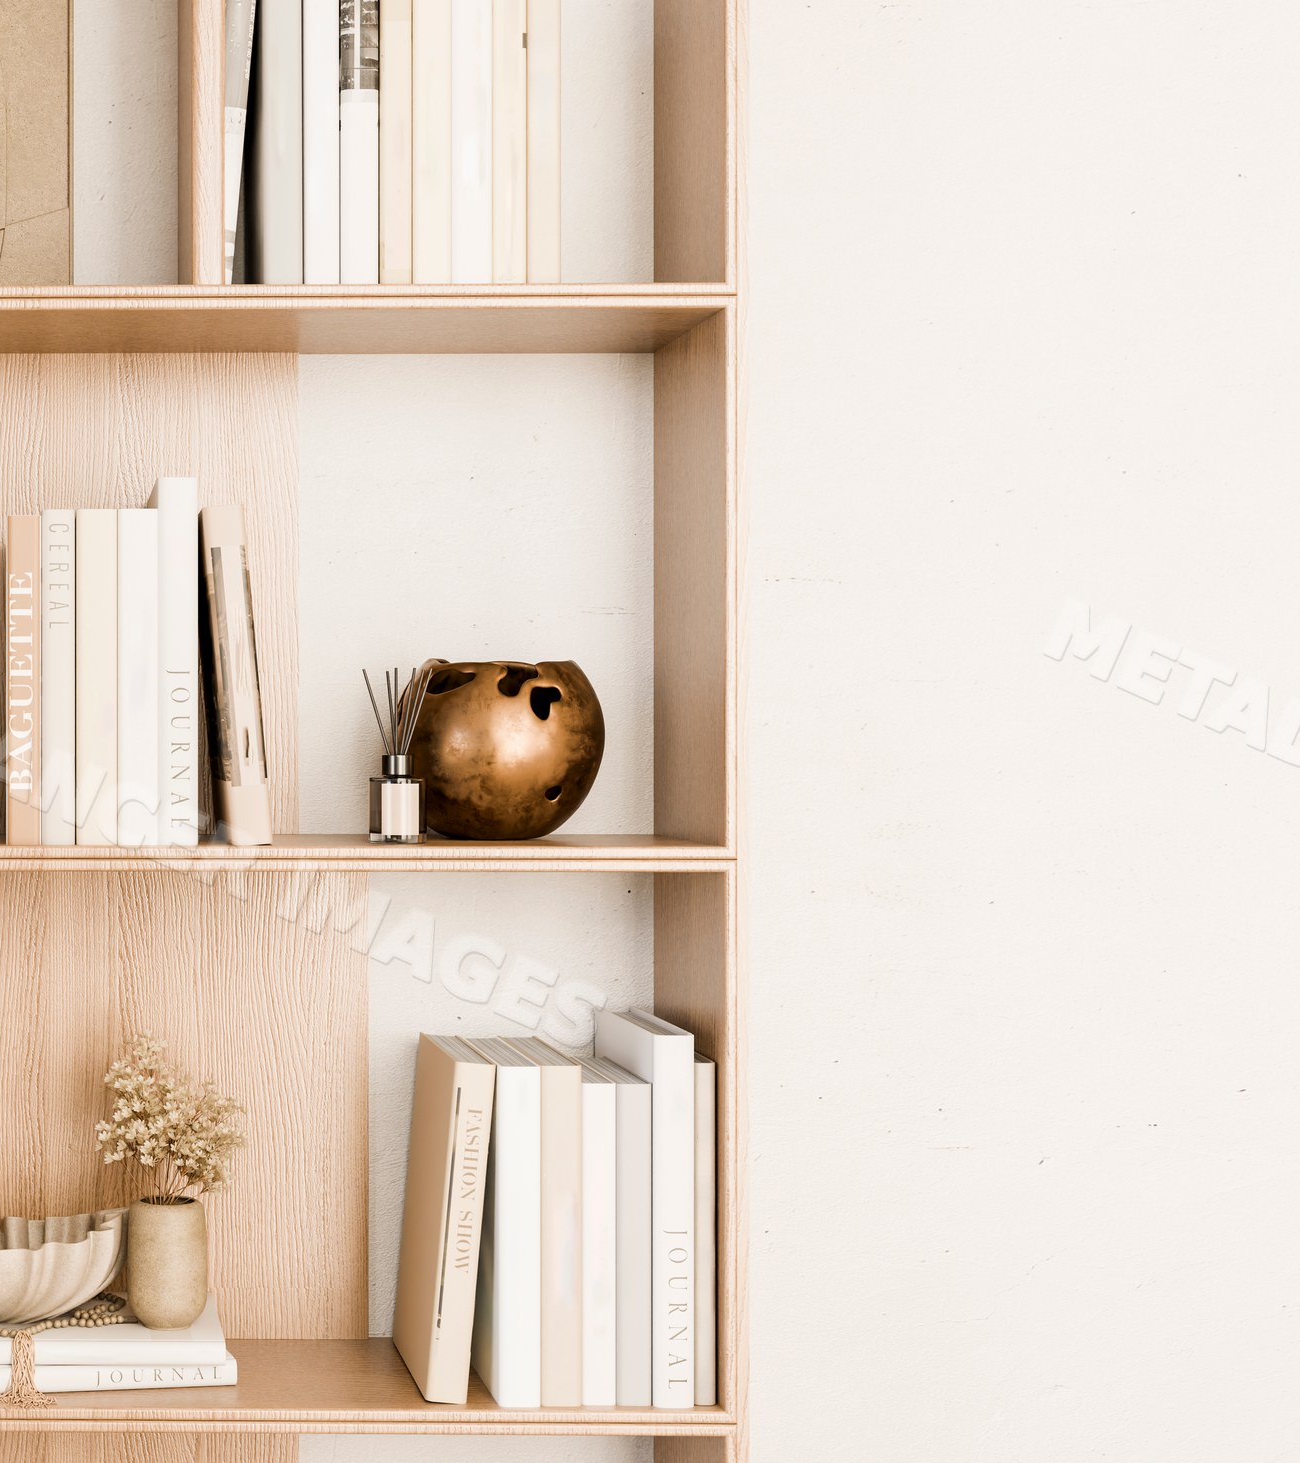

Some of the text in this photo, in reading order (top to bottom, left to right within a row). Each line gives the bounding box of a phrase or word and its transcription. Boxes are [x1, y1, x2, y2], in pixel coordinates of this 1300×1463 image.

[48, 523, 70, 629] CEREAL
[9, 571, 33, 793] BAGUETTE
[166, 669, 191, 829] JOURNAL
[454, 1108, 483, 1274] FASHION SHOW
[96, 1366, 223, 1387] JOURNAL
[663, 1230, 688, 1390] JOURNAL
